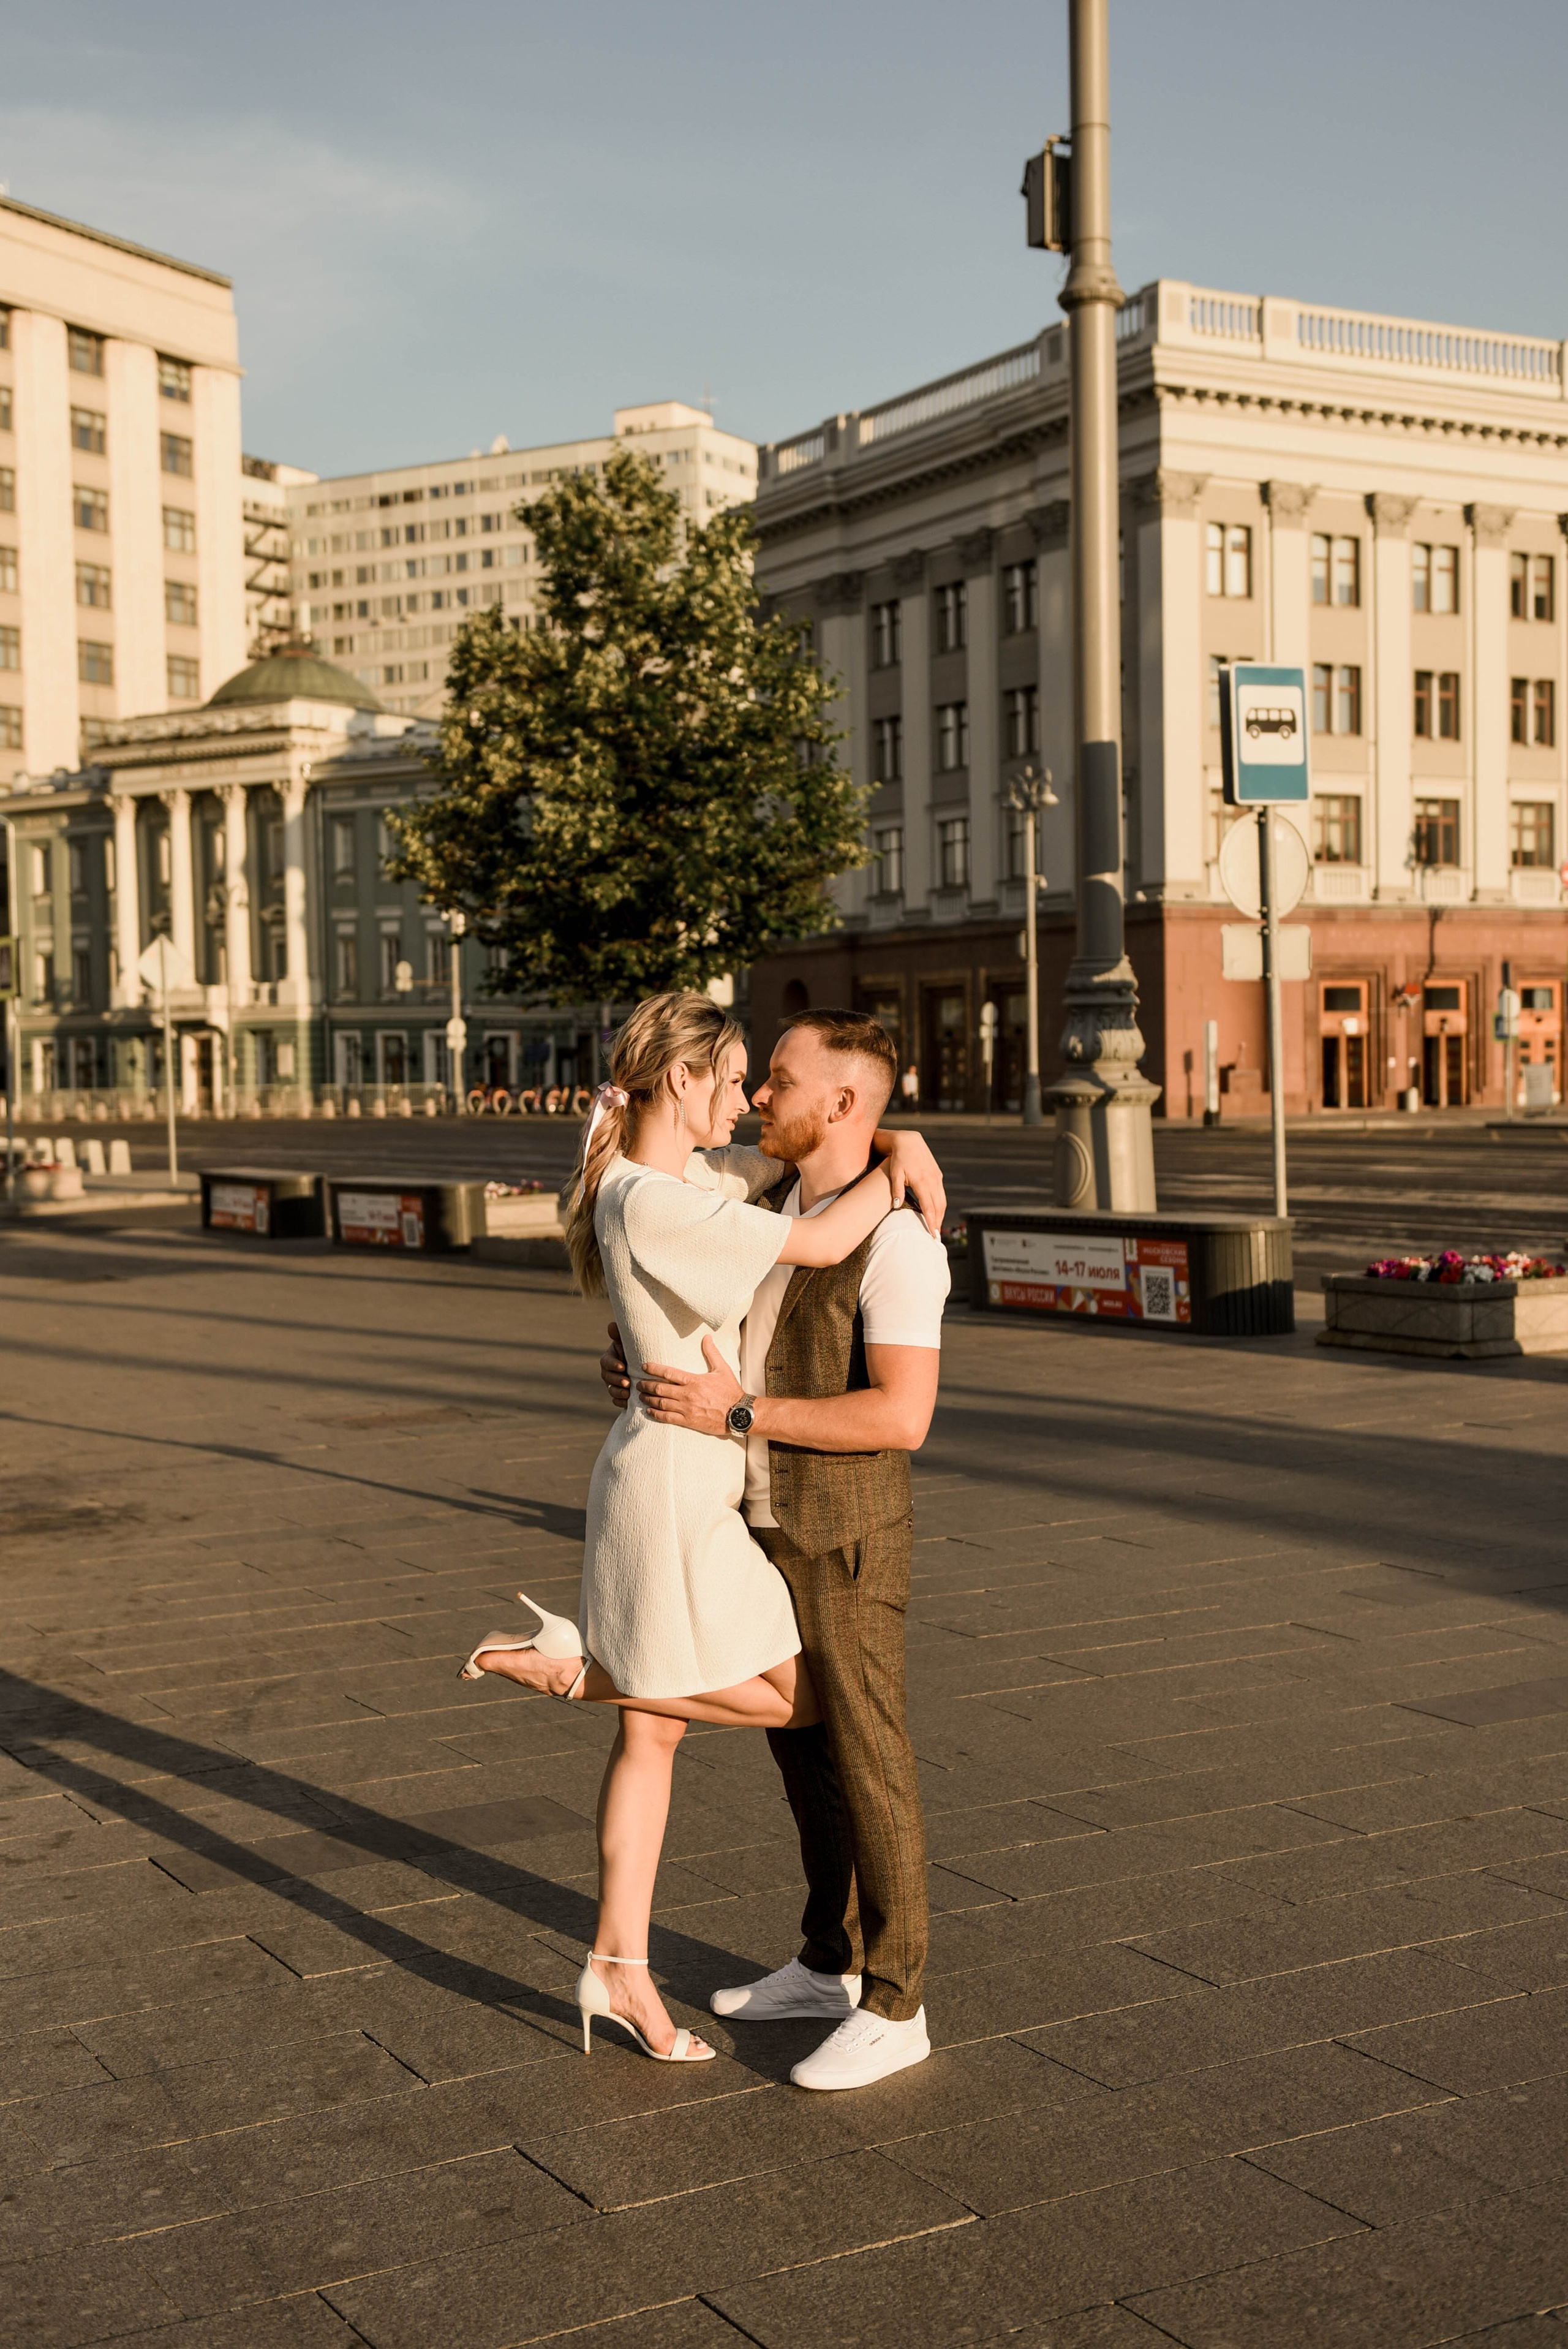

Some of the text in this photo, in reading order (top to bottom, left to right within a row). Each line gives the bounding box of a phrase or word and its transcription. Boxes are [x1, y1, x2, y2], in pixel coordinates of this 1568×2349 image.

[1055, 1260, 1085, 1276] 14-17
[1088, 1266, 1120, 1280] июля
[1028, 1288, 1055, 1303] РОССИИ
